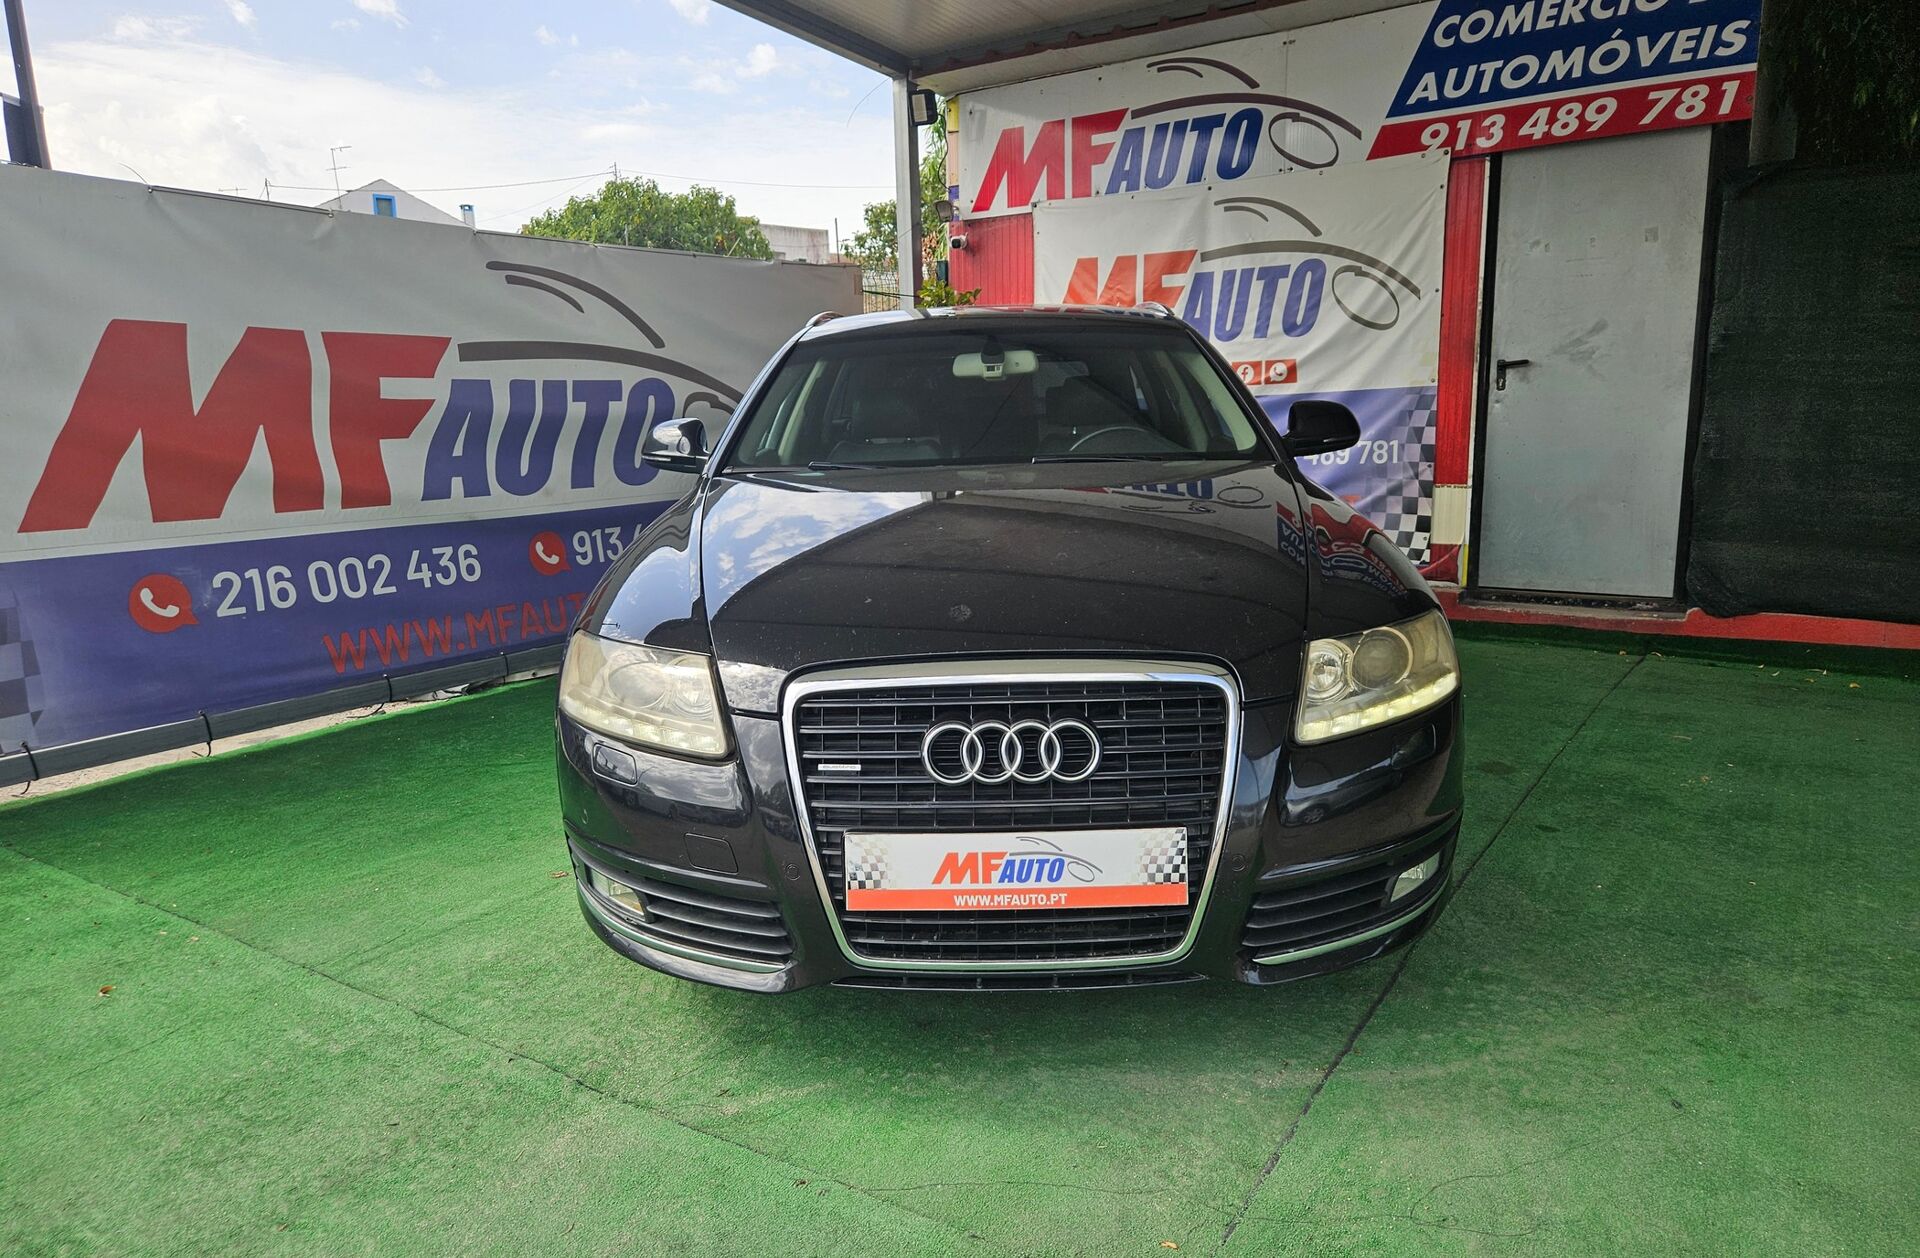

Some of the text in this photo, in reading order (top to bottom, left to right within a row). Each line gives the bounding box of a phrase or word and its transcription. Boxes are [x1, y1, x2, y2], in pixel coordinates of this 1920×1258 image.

[1406, 20, 1751, 105] AUTOMÓVEIS
[1420, 80, 1741, 151] 913 489 781
[1358, 440, 1399, 464] 781
[212, 565, 297, 617] 216
[307, 553, 397, 603] 002
[406, 544, 482, 588] 436
[572, 526, 624, 566] 913
[953, 893, 1068, 907] WWW.MFAUTO.PT
